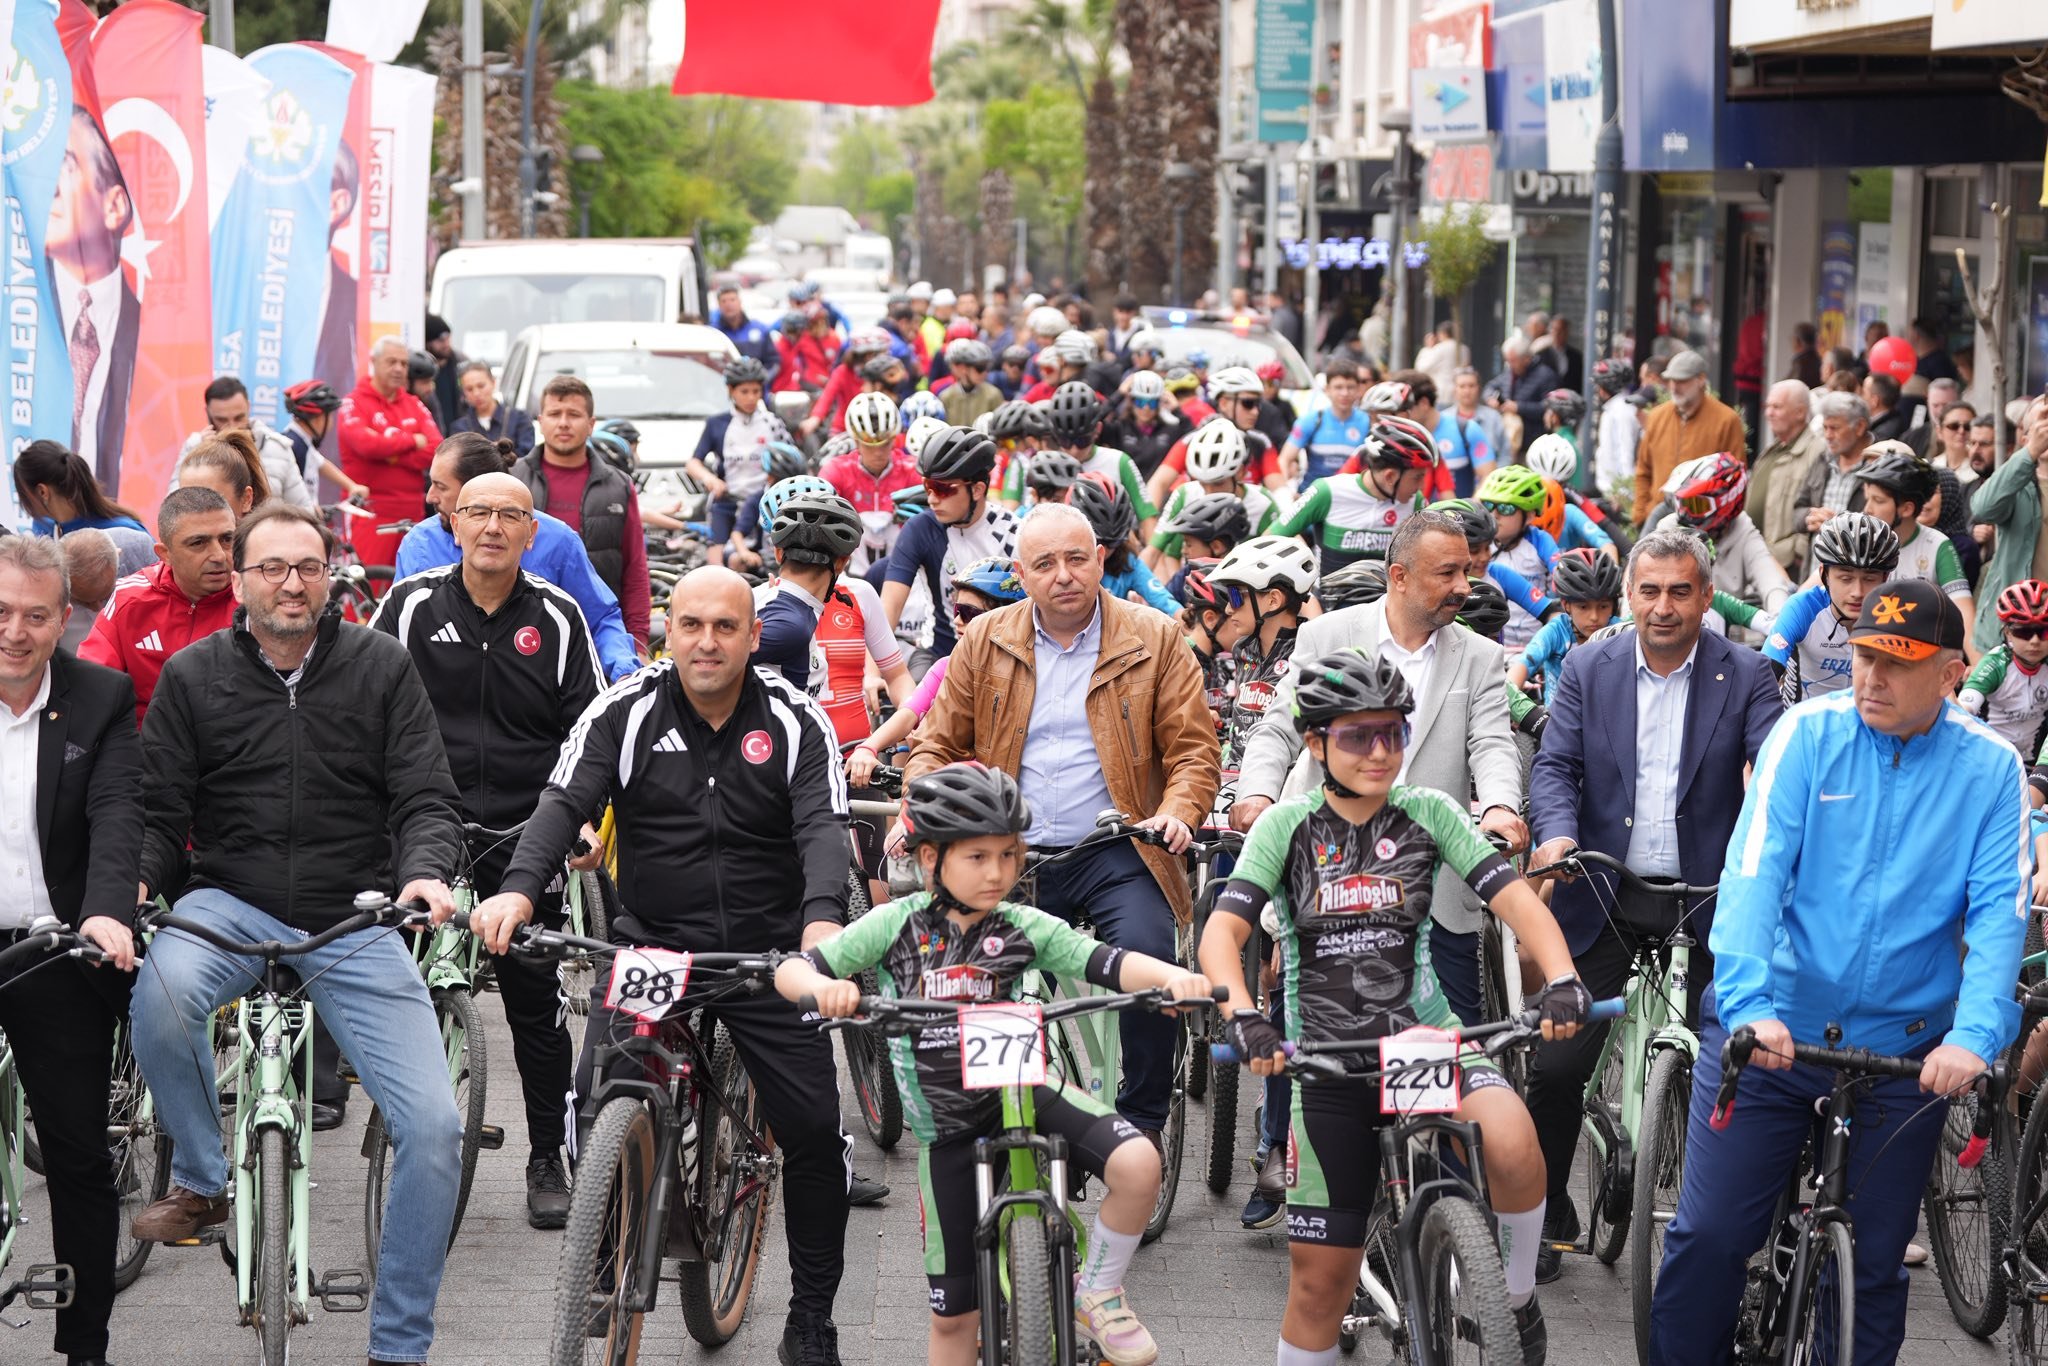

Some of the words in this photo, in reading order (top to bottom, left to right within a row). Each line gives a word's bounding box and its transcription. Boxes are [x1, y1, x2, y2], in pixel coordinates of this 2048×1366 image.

[620, 966, 675, 1005] 88
[966, 1031, 1038, 1068] 277
[1385, 1058, 1455, 1090] 220
